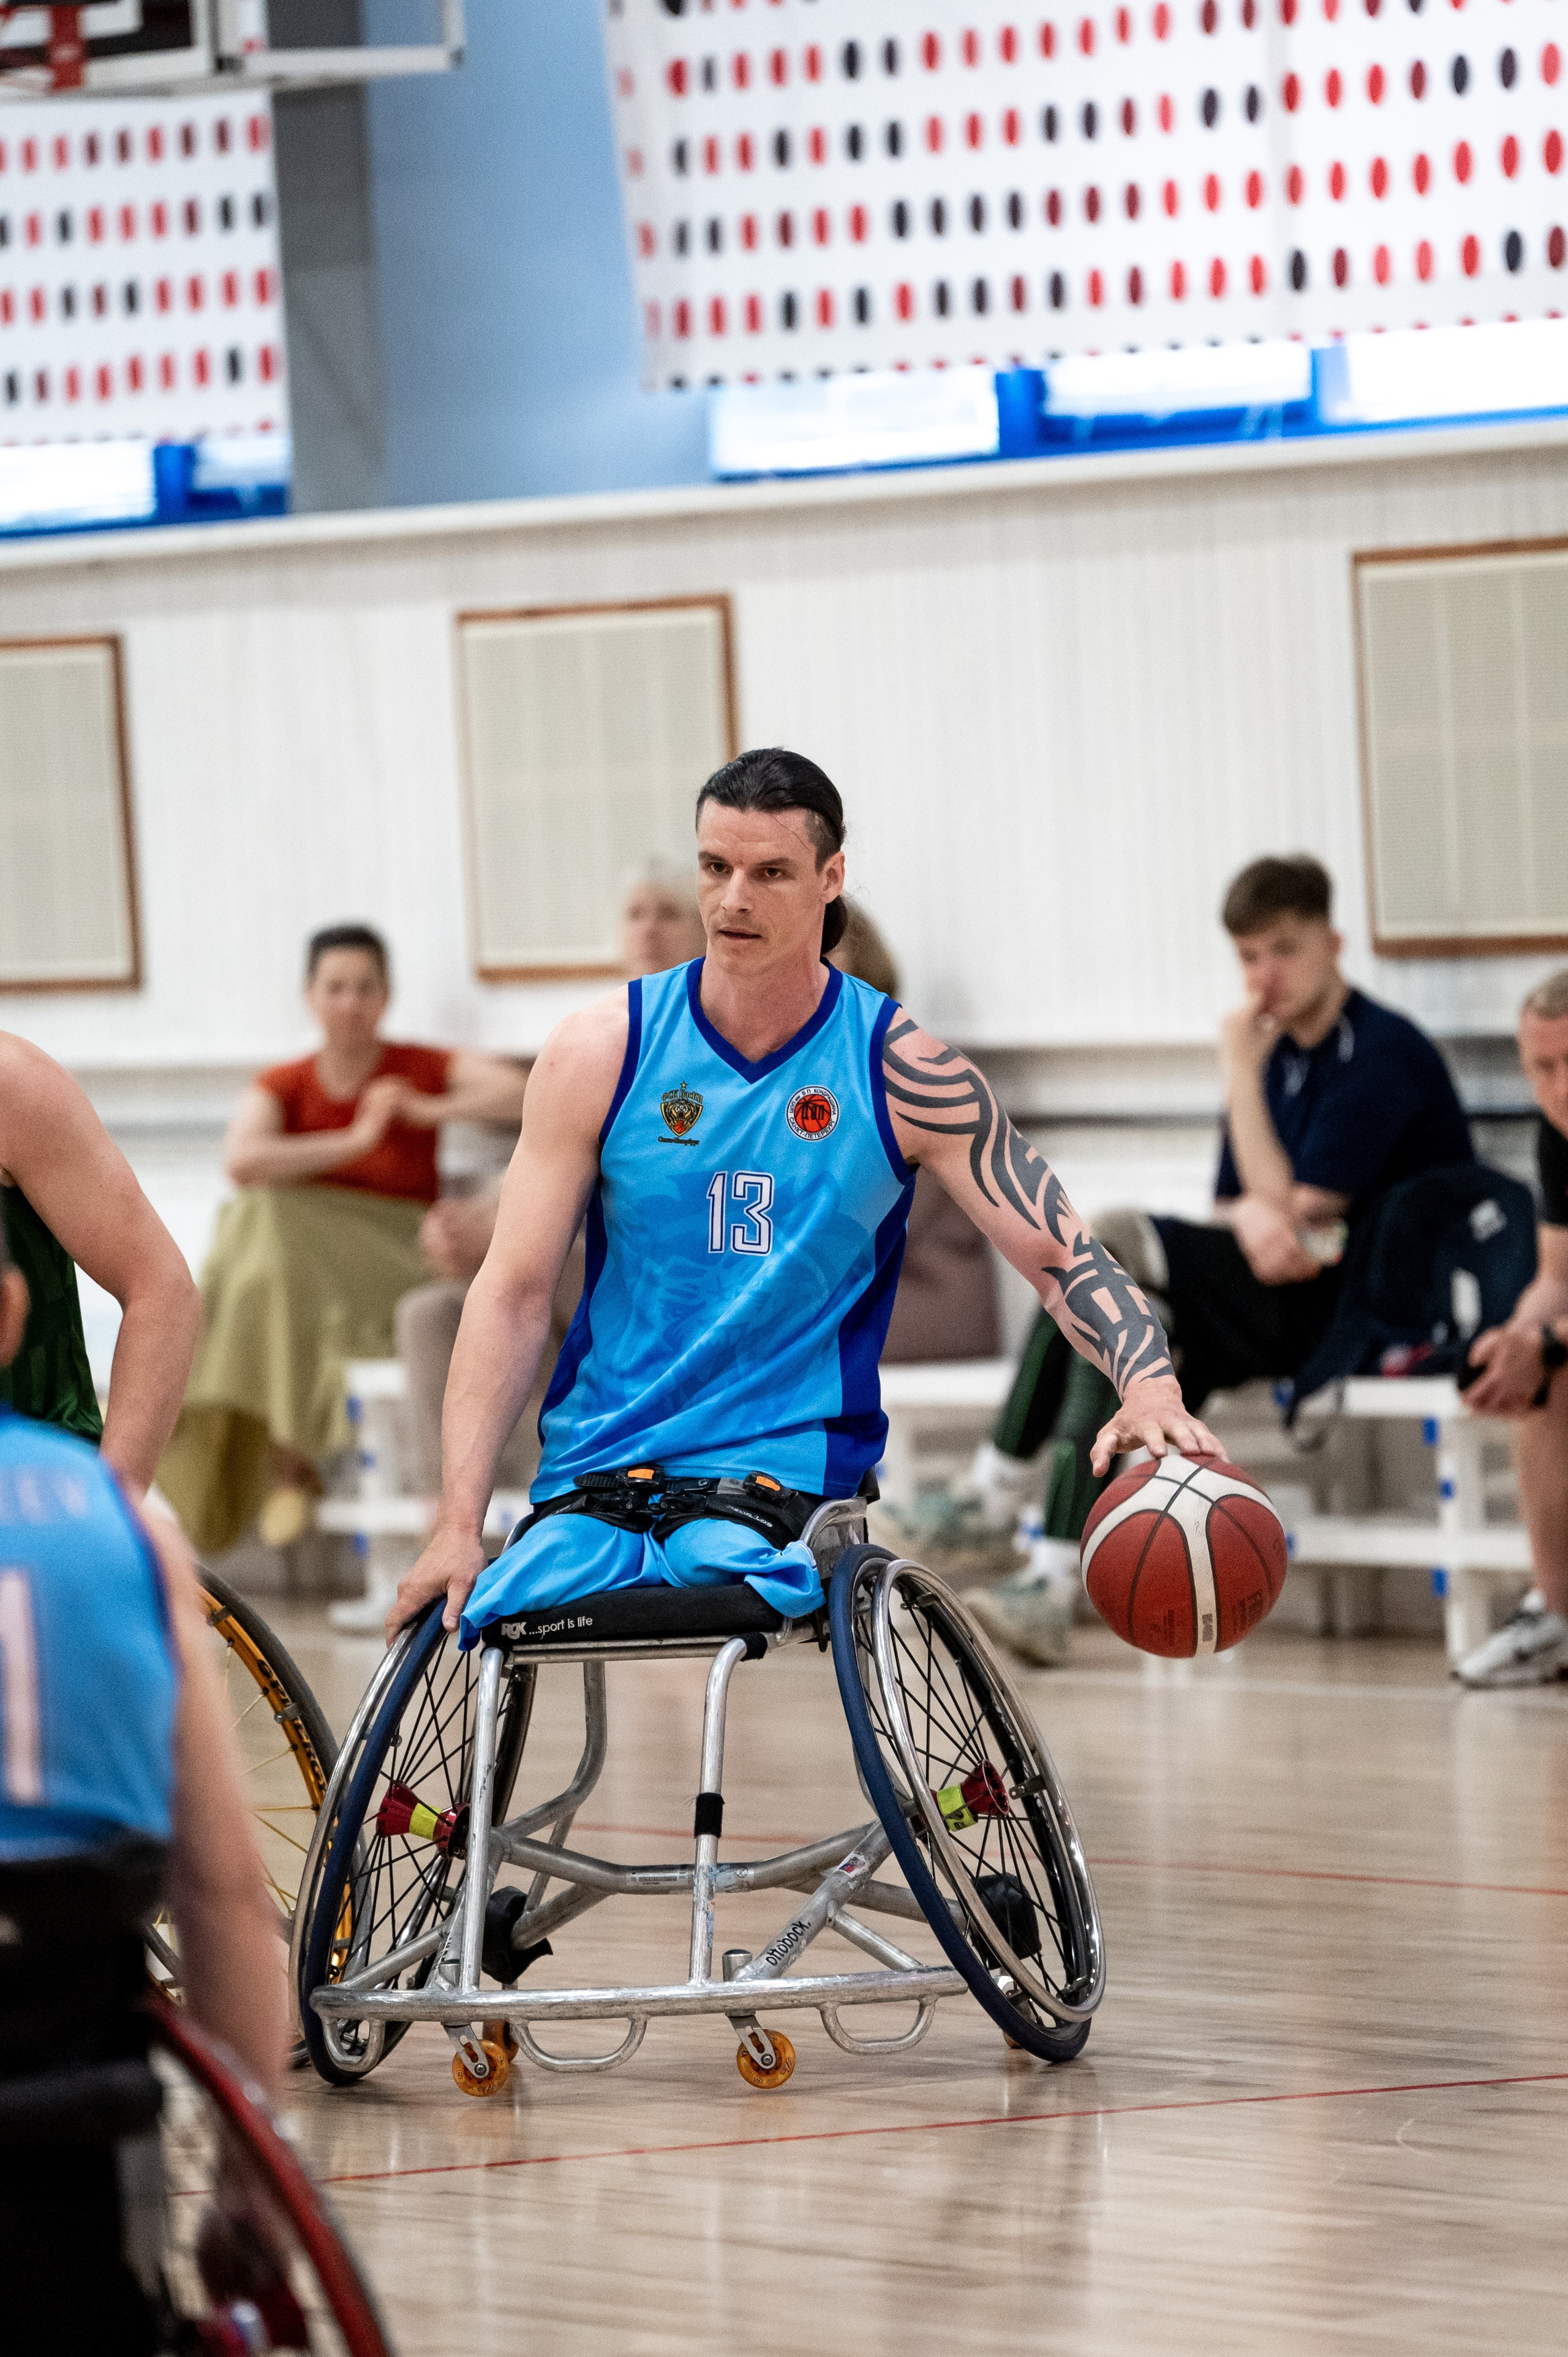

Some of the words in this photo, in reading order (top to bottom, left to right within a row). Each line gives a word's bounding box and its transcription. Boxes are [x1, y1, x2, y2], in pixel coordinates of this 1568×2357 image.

[789, 1117, 835, 1139] САНКТ-ПЕТЕРБУРГ
[706, 1170, 775, 1257] 13
[567, 1618, 575, 1629] is
[577, 1616, 594, 1628] life
